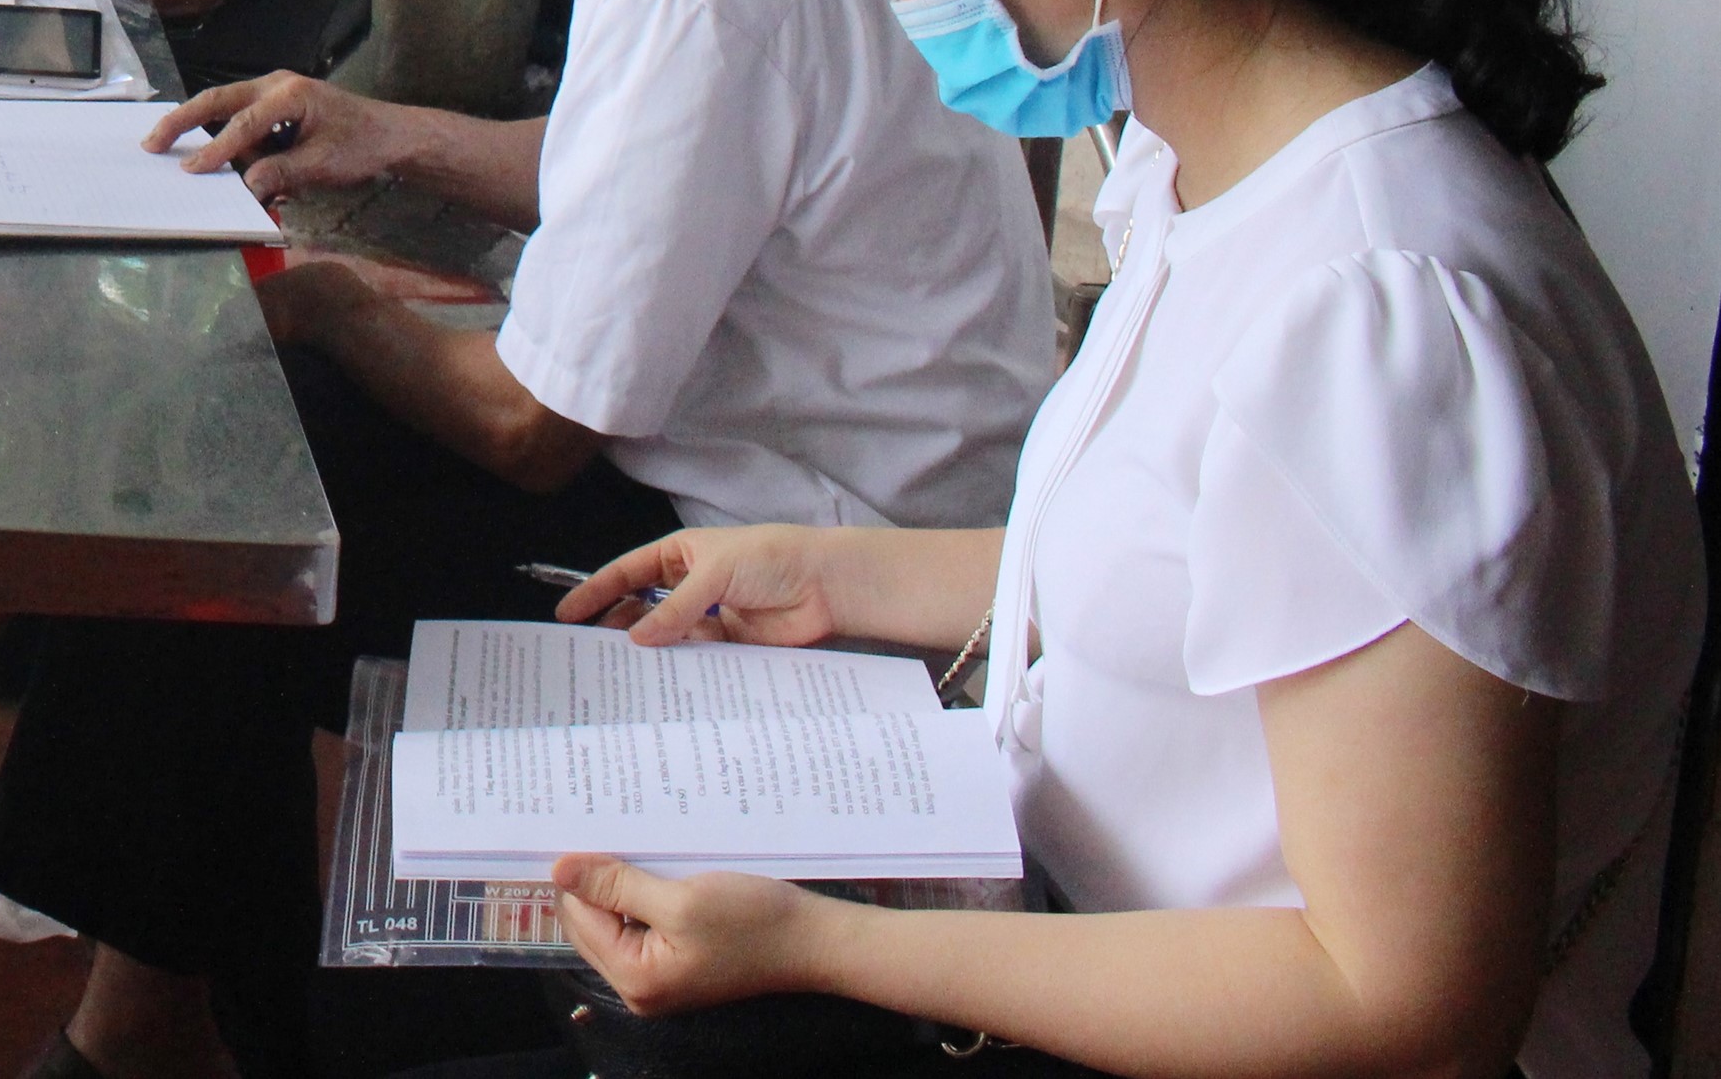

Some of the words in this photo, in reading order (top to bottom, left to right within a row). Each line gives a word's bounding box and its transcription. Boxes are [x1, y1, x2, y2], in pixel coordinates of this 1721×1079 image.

[504, 887, 530, 897] 209
[357, 920, 379, 934] TL
[385, 917, 418, 931] 048
